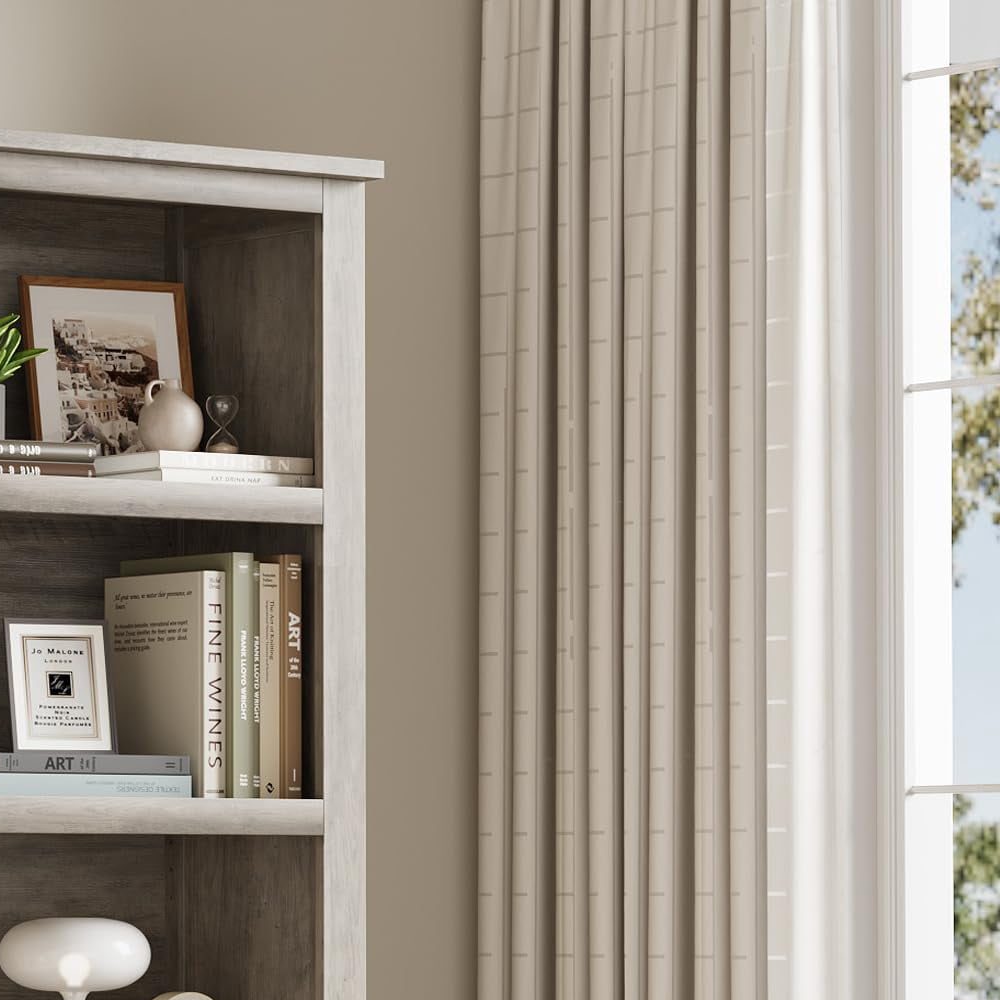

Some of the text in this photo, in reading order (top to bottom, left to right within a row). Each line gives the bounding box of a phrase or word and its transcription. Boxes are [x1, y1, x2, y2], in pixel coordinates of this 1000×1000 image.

[208, 603, 222, 663] FINE
[287, 611, 301, 651] ART
[208, 677, 222, 768] WINES
[45, 757, 74, 770] ART
